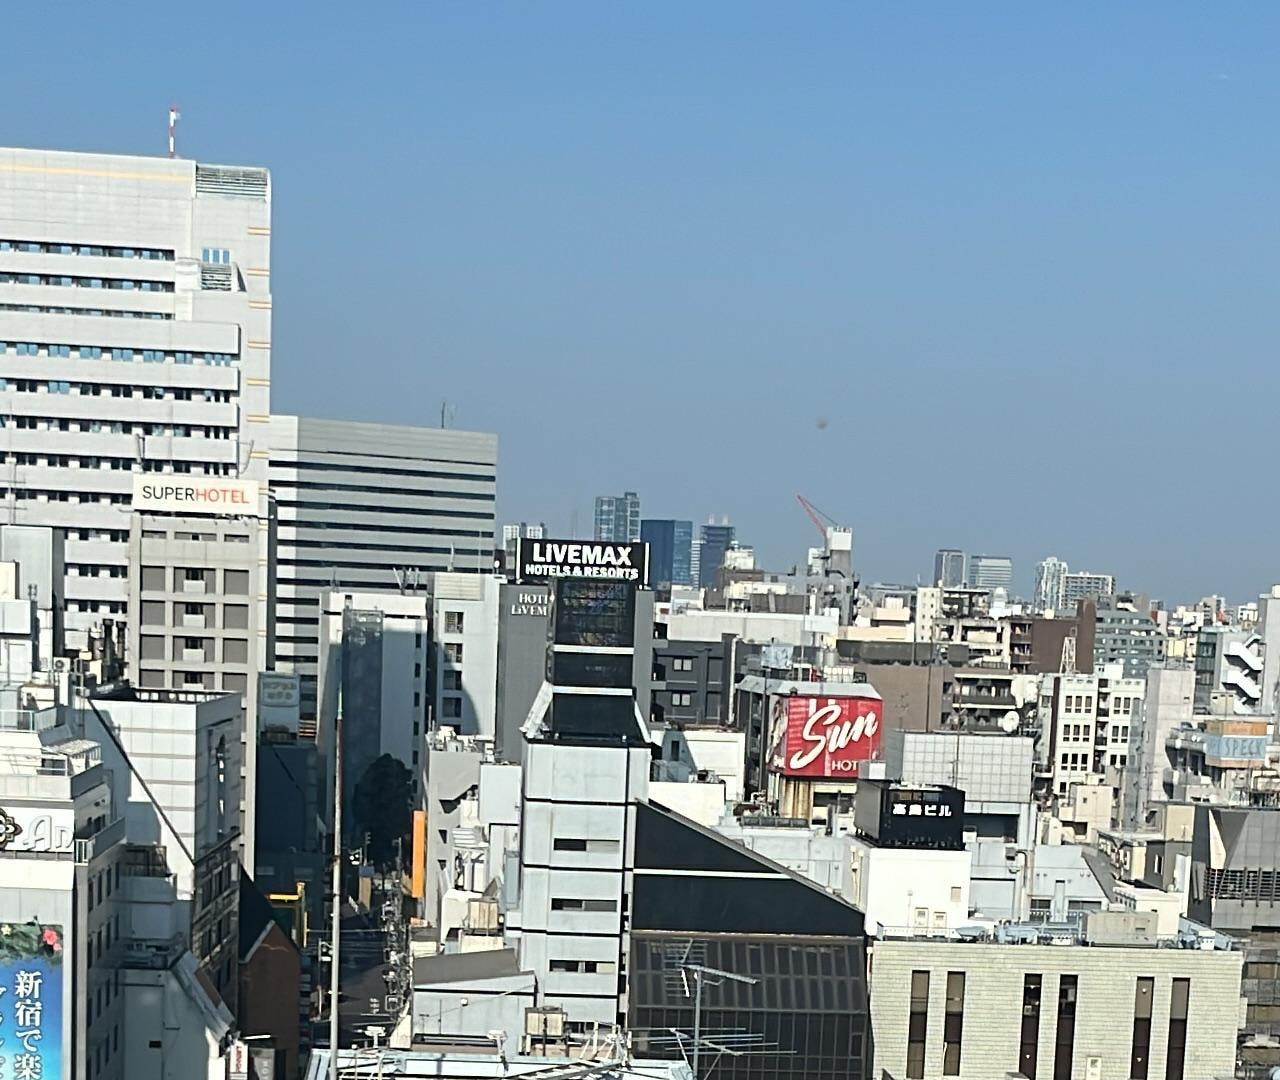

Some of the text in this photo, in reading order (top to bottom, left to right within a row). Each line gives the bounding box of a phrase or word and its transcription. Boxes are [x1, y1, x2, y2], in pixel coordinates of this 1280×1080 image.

[525, 564, 572, 577] HOTELS
[584, 566, 639, 581] RESORTS
[790, 704, 879, 770] Sun
[23, 814, 75, 851] An
